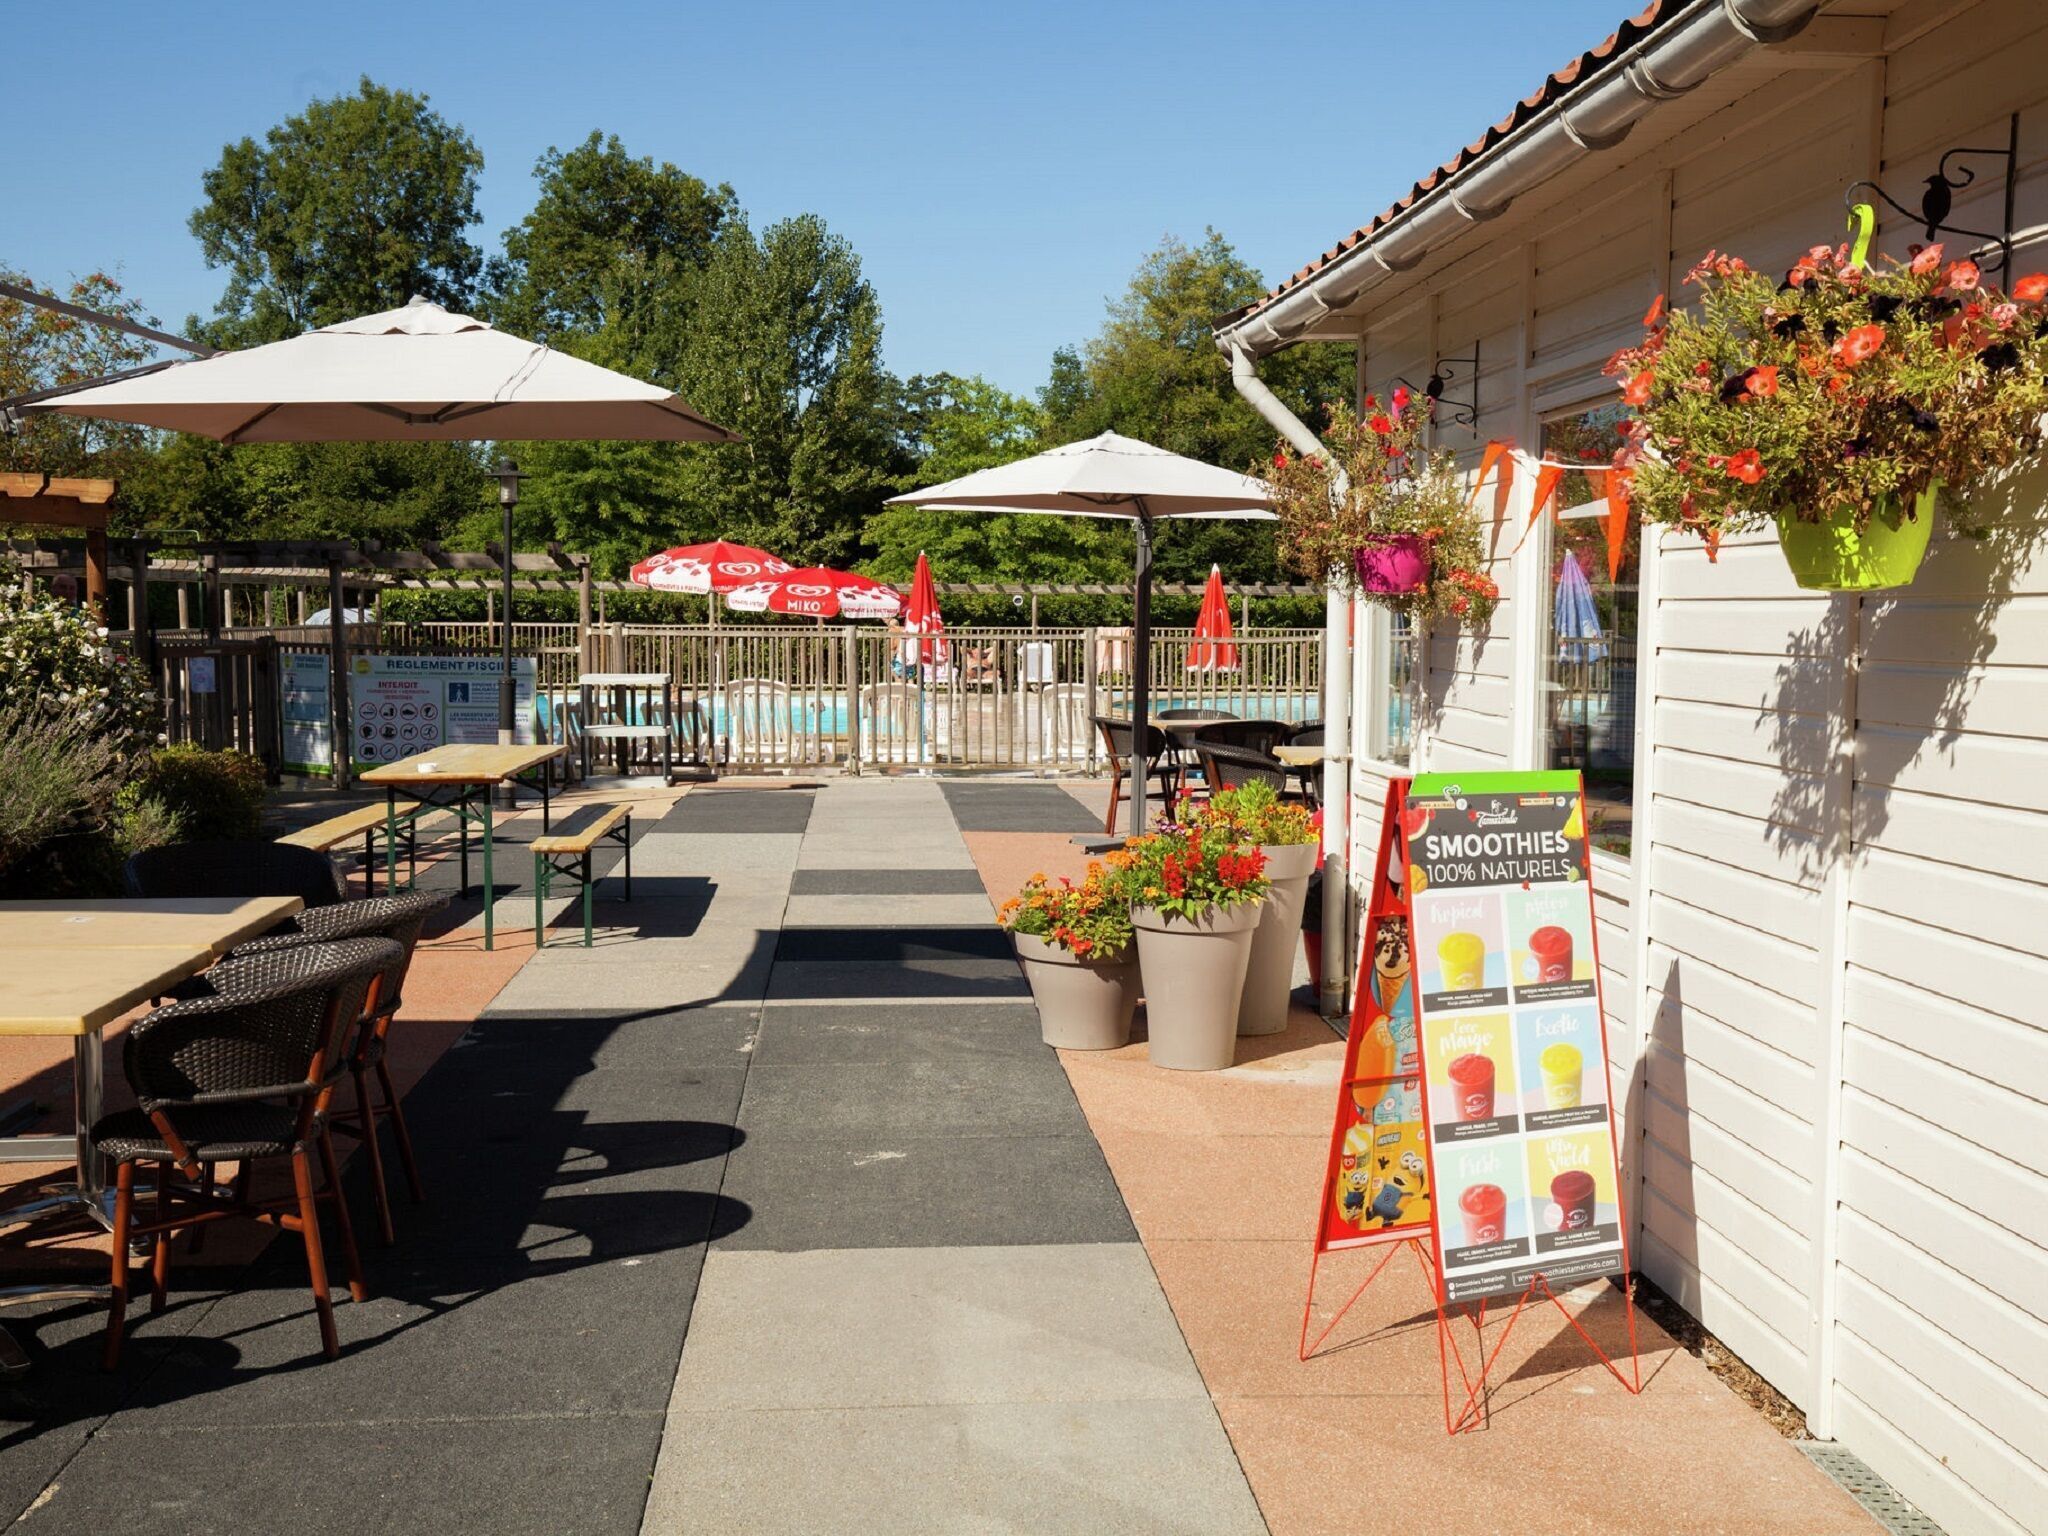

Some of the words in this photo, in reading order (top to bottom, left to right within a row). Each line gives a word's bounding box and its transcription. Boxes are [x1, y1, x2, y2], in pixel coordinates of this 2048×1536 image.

[787, 599, 821, 612] MIKO
[386, 659, 464, 671] REGLEMENT
[467, 660, 518, 672] PISCIE
[378, 681, 419, 689] INTERDIT
[1426, 830, 1570, 860] SMOOTHIES
[1427, 862, 1476, 883] 100%
[1481, 858, 1571, 880] NATURELS
[1439, 1030, 1494, 1057] Mango
